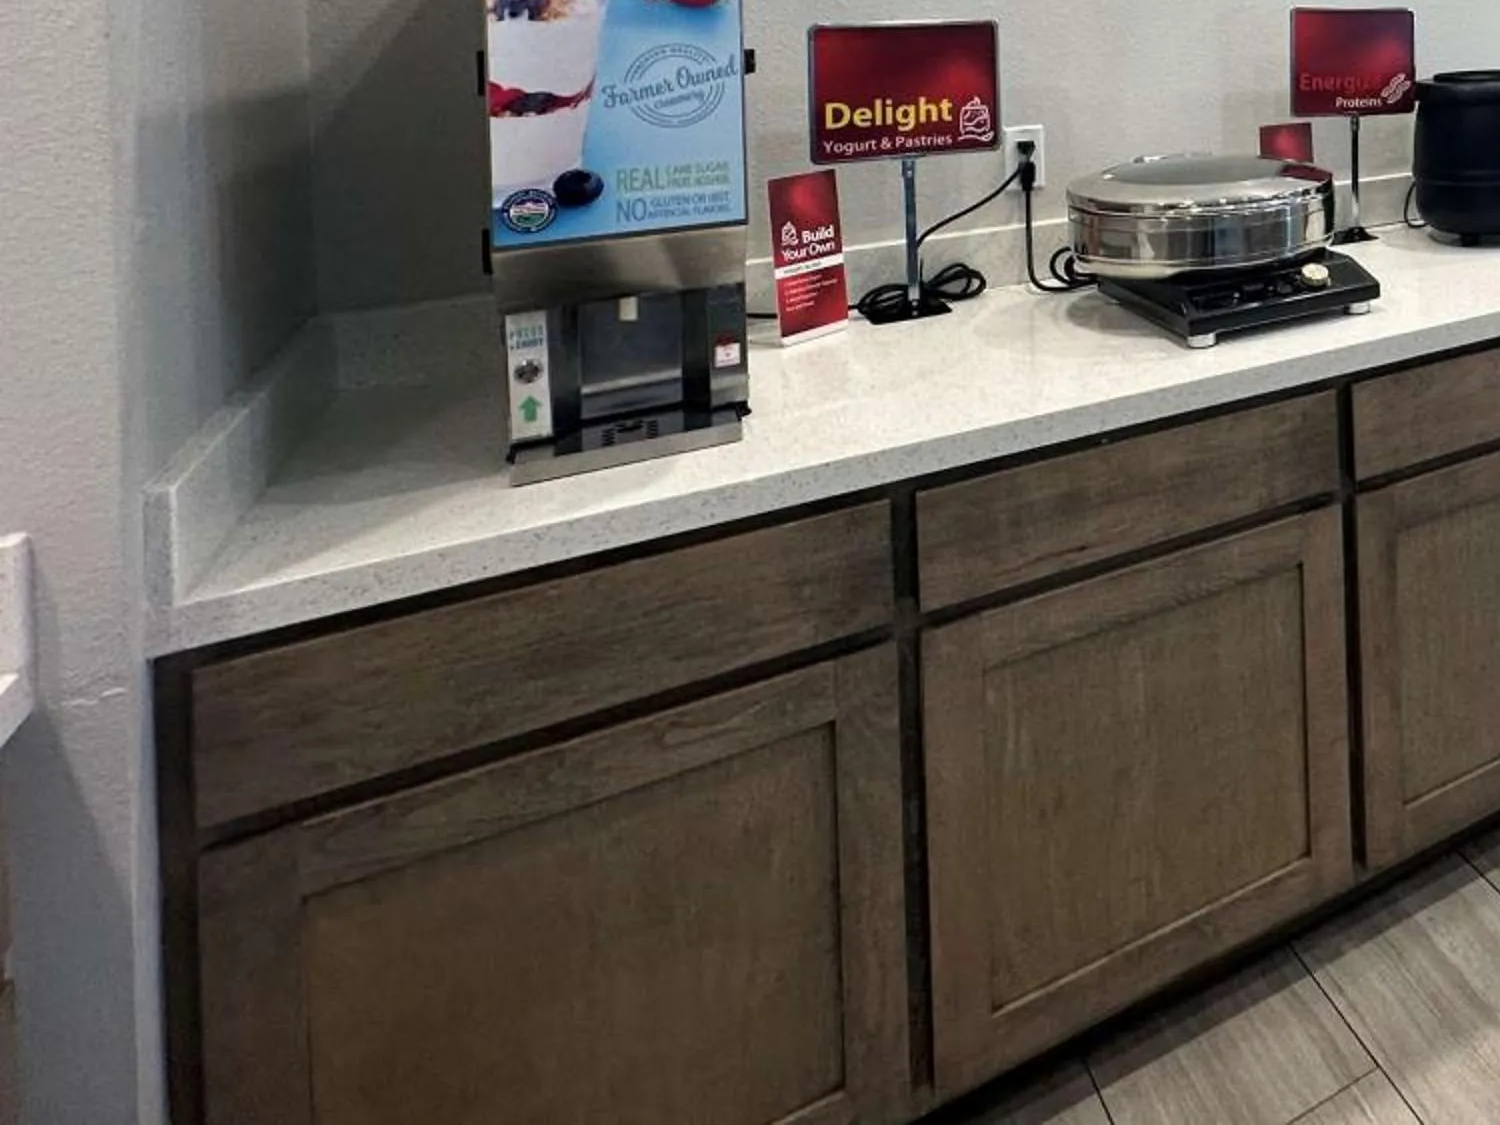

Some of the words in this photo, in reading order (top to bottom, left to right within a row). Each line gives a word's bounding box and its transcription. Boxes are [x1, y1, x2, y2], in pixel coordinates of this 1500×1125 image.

[601, 78, 674, 108] Farmer
[675, 53, 738, 88] Owned
[1335, 96, 1382, 108] Proteins
[824, 96, 953, 132] Delight
[823, 139, 877, 155] Yogurt
[880, 137, 892, 150] &
[895, 134, 953, 148] Pastries
[616, 165, 664, 192] REAL
[616, 197, 647, 223] NO
[802, 224, 834, 243] Build
[782, 248, 807, 262] Your
[809, 242, 835, 256] Own
